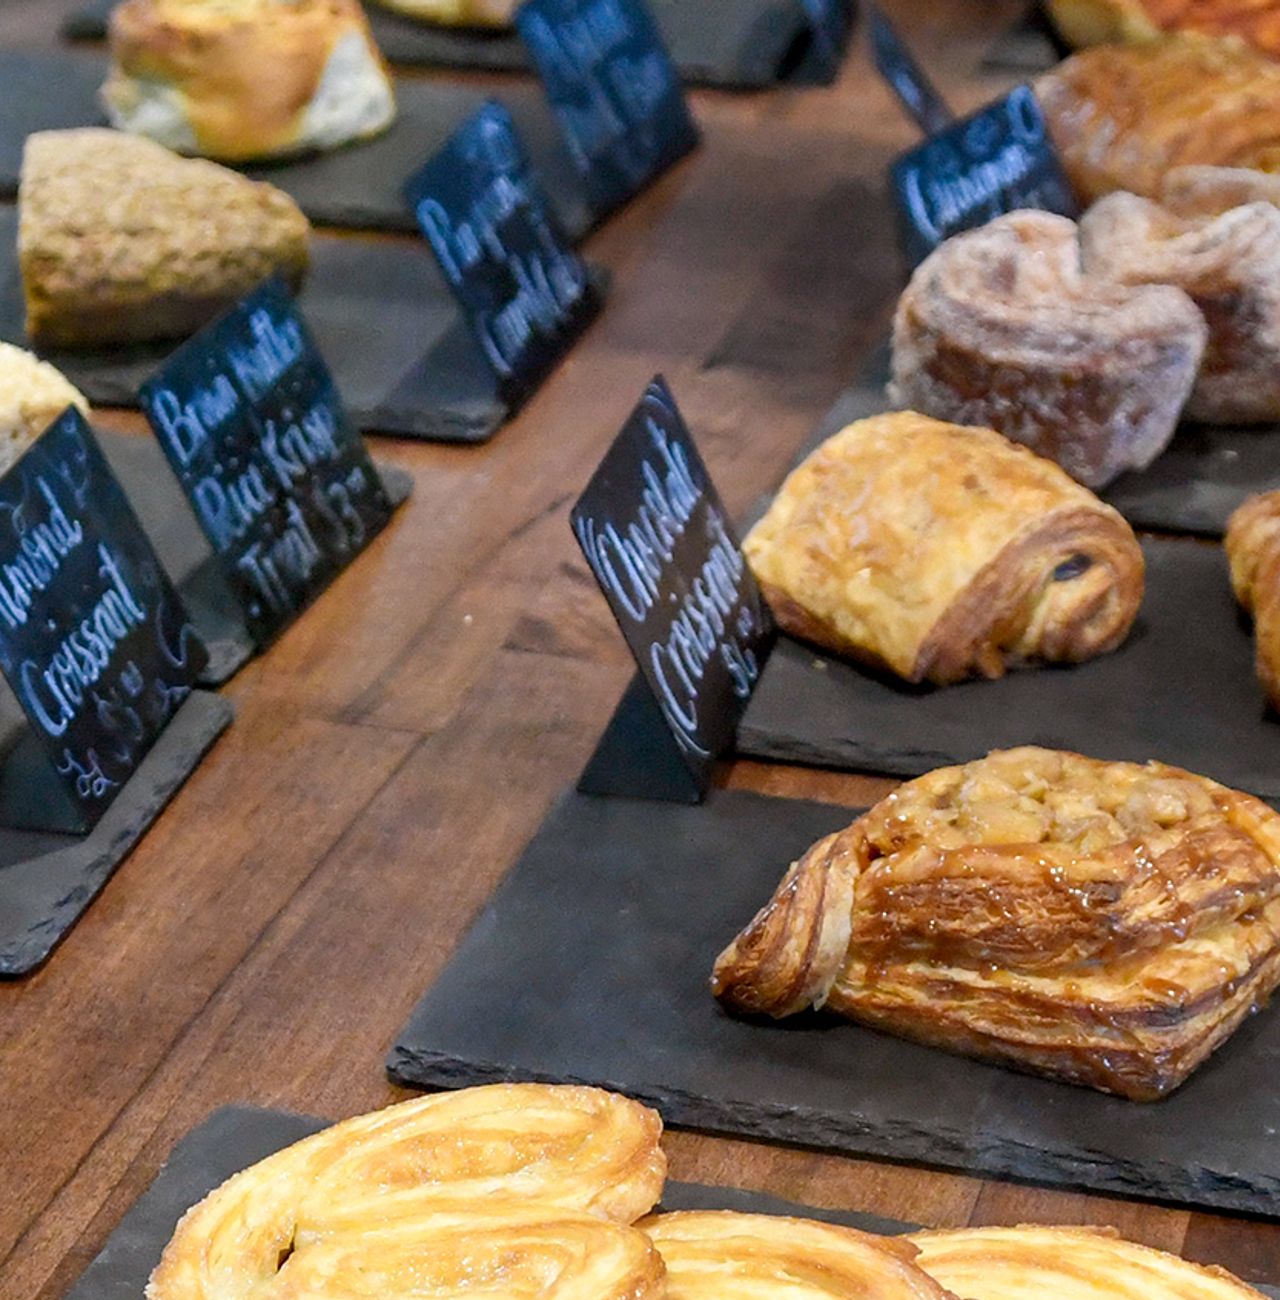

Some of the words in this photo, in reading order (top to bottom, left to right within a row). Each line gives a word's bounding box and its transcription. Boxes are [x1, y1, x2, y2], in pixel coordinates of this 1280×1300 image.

[598, 416, 703, 624] Chocolate
[651, 504, 744, 733] Croissant
[21, 545, 145, 738] Croissant
